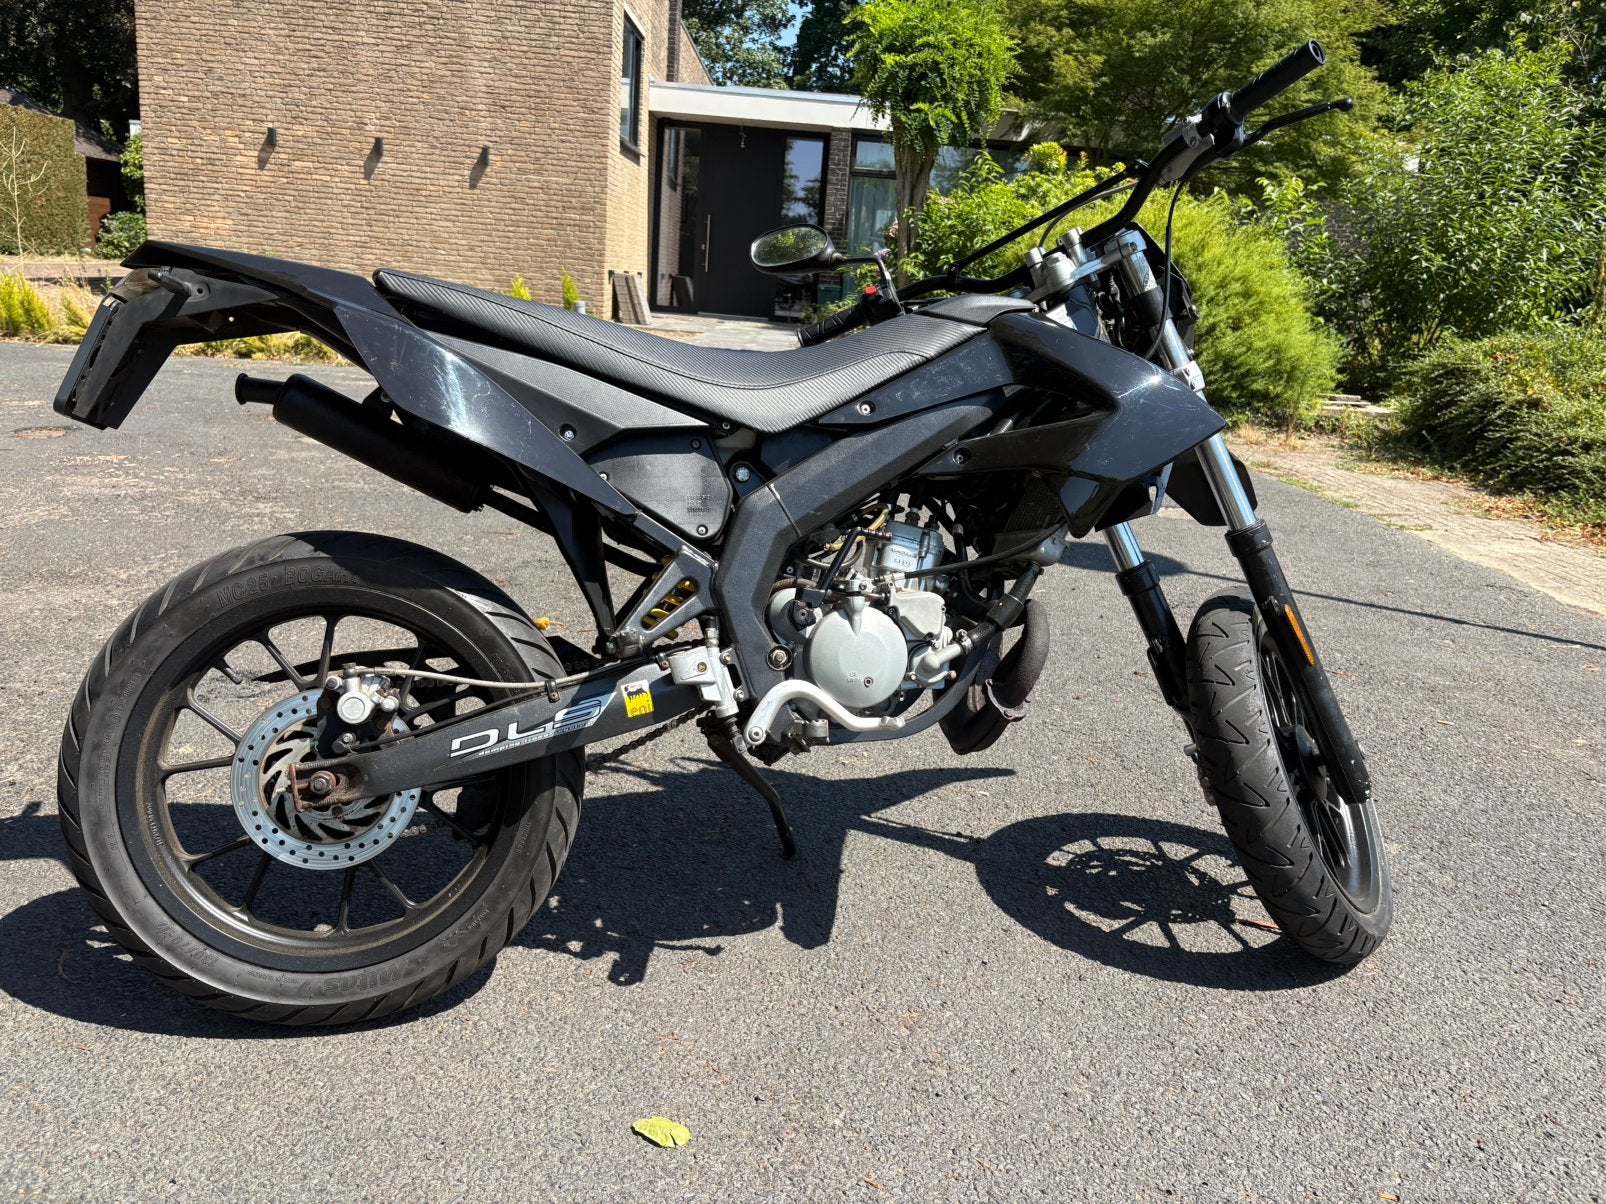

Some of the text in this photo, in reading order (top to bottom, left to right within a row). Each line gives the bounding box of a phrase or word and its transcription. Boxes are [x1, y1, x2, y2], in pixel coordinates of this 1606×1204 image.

[284, 564, 360, 586] BOGAR
[629, 702, 655, 716] eni
[450, 699, 602, 758] DLS
[322, 961, 410, 994] Mitas
